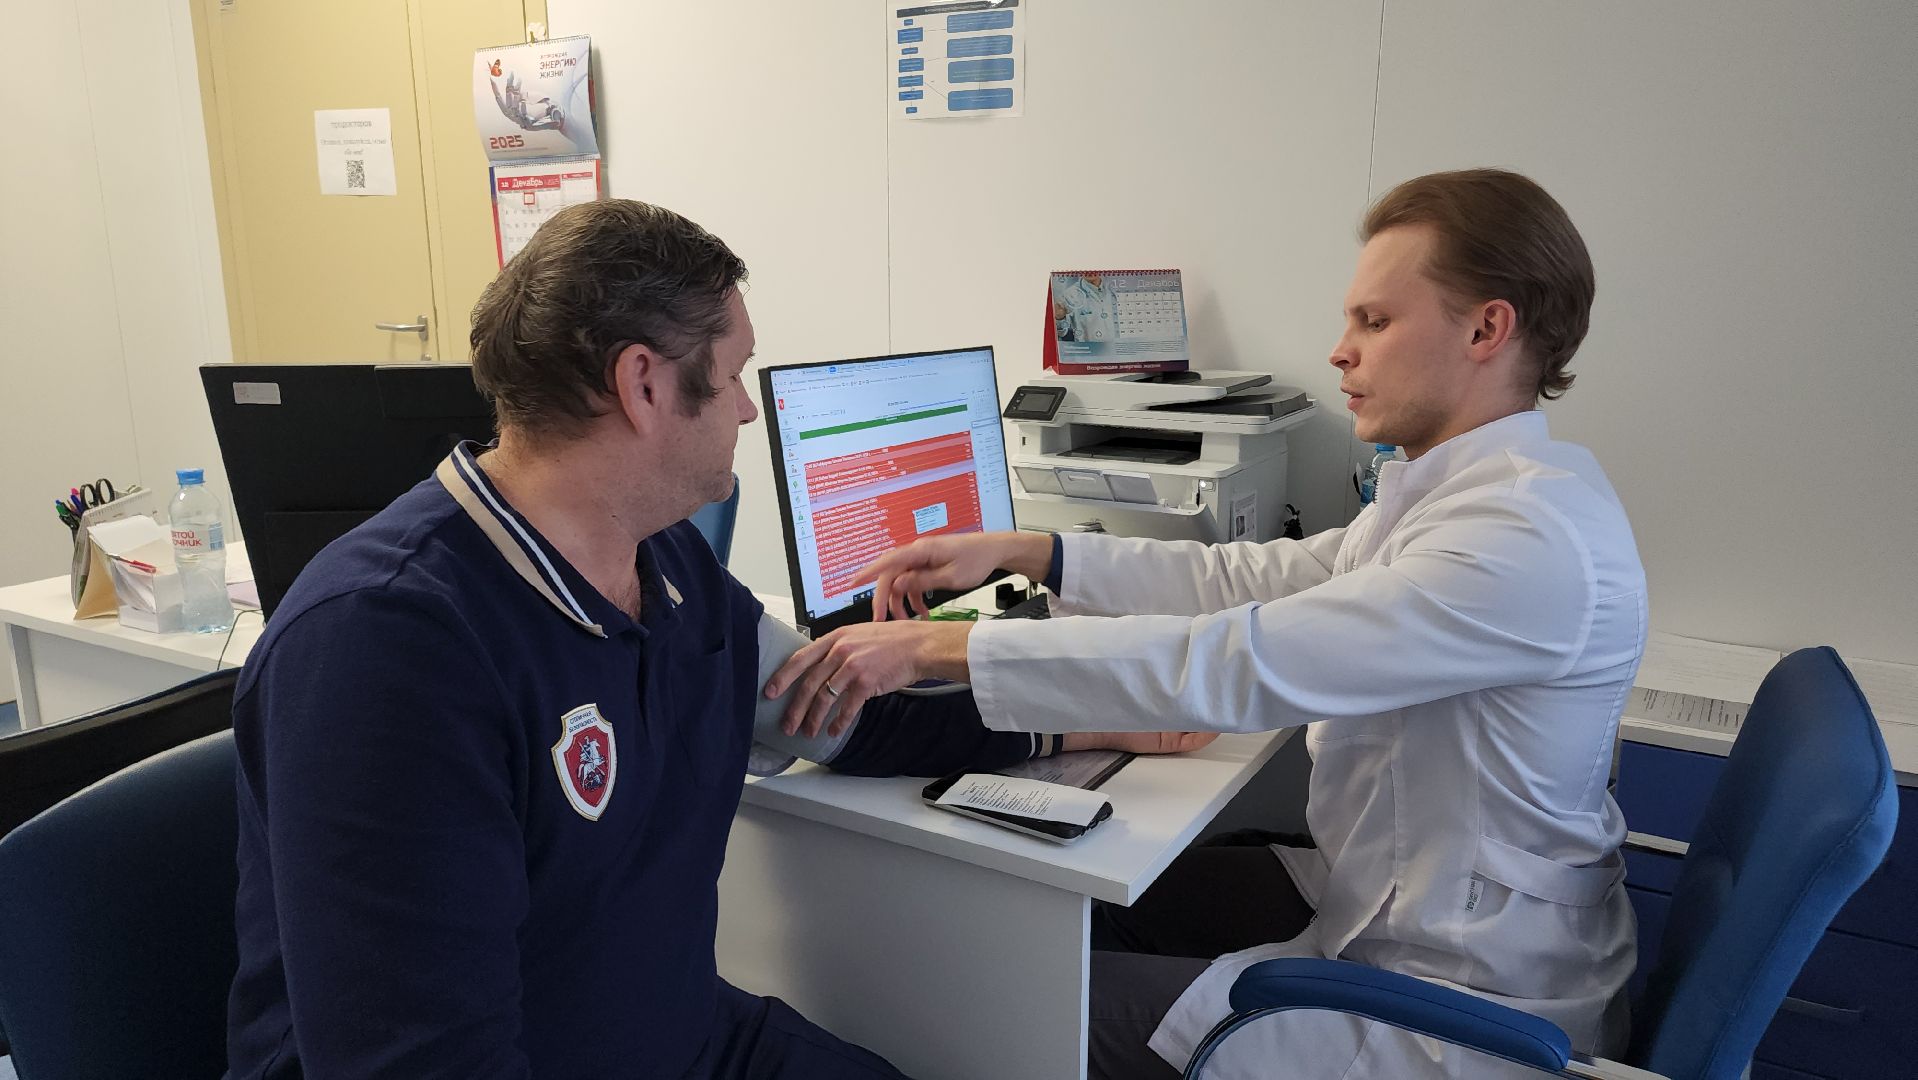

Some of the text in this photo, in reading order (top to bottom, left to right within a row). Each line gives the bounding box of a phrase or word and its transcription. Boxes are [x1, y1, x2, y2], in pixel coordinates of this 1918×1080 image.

[539, 57, 577, 70] ЭНЕРГИЮ
[539, 69, 564, 79] ЖИЗНИ
[489, 135, 525, 149] 2025
[511, 177, 544, 188] Декабрь
[1112, 279, 1180, 288] 12 Декабрь
